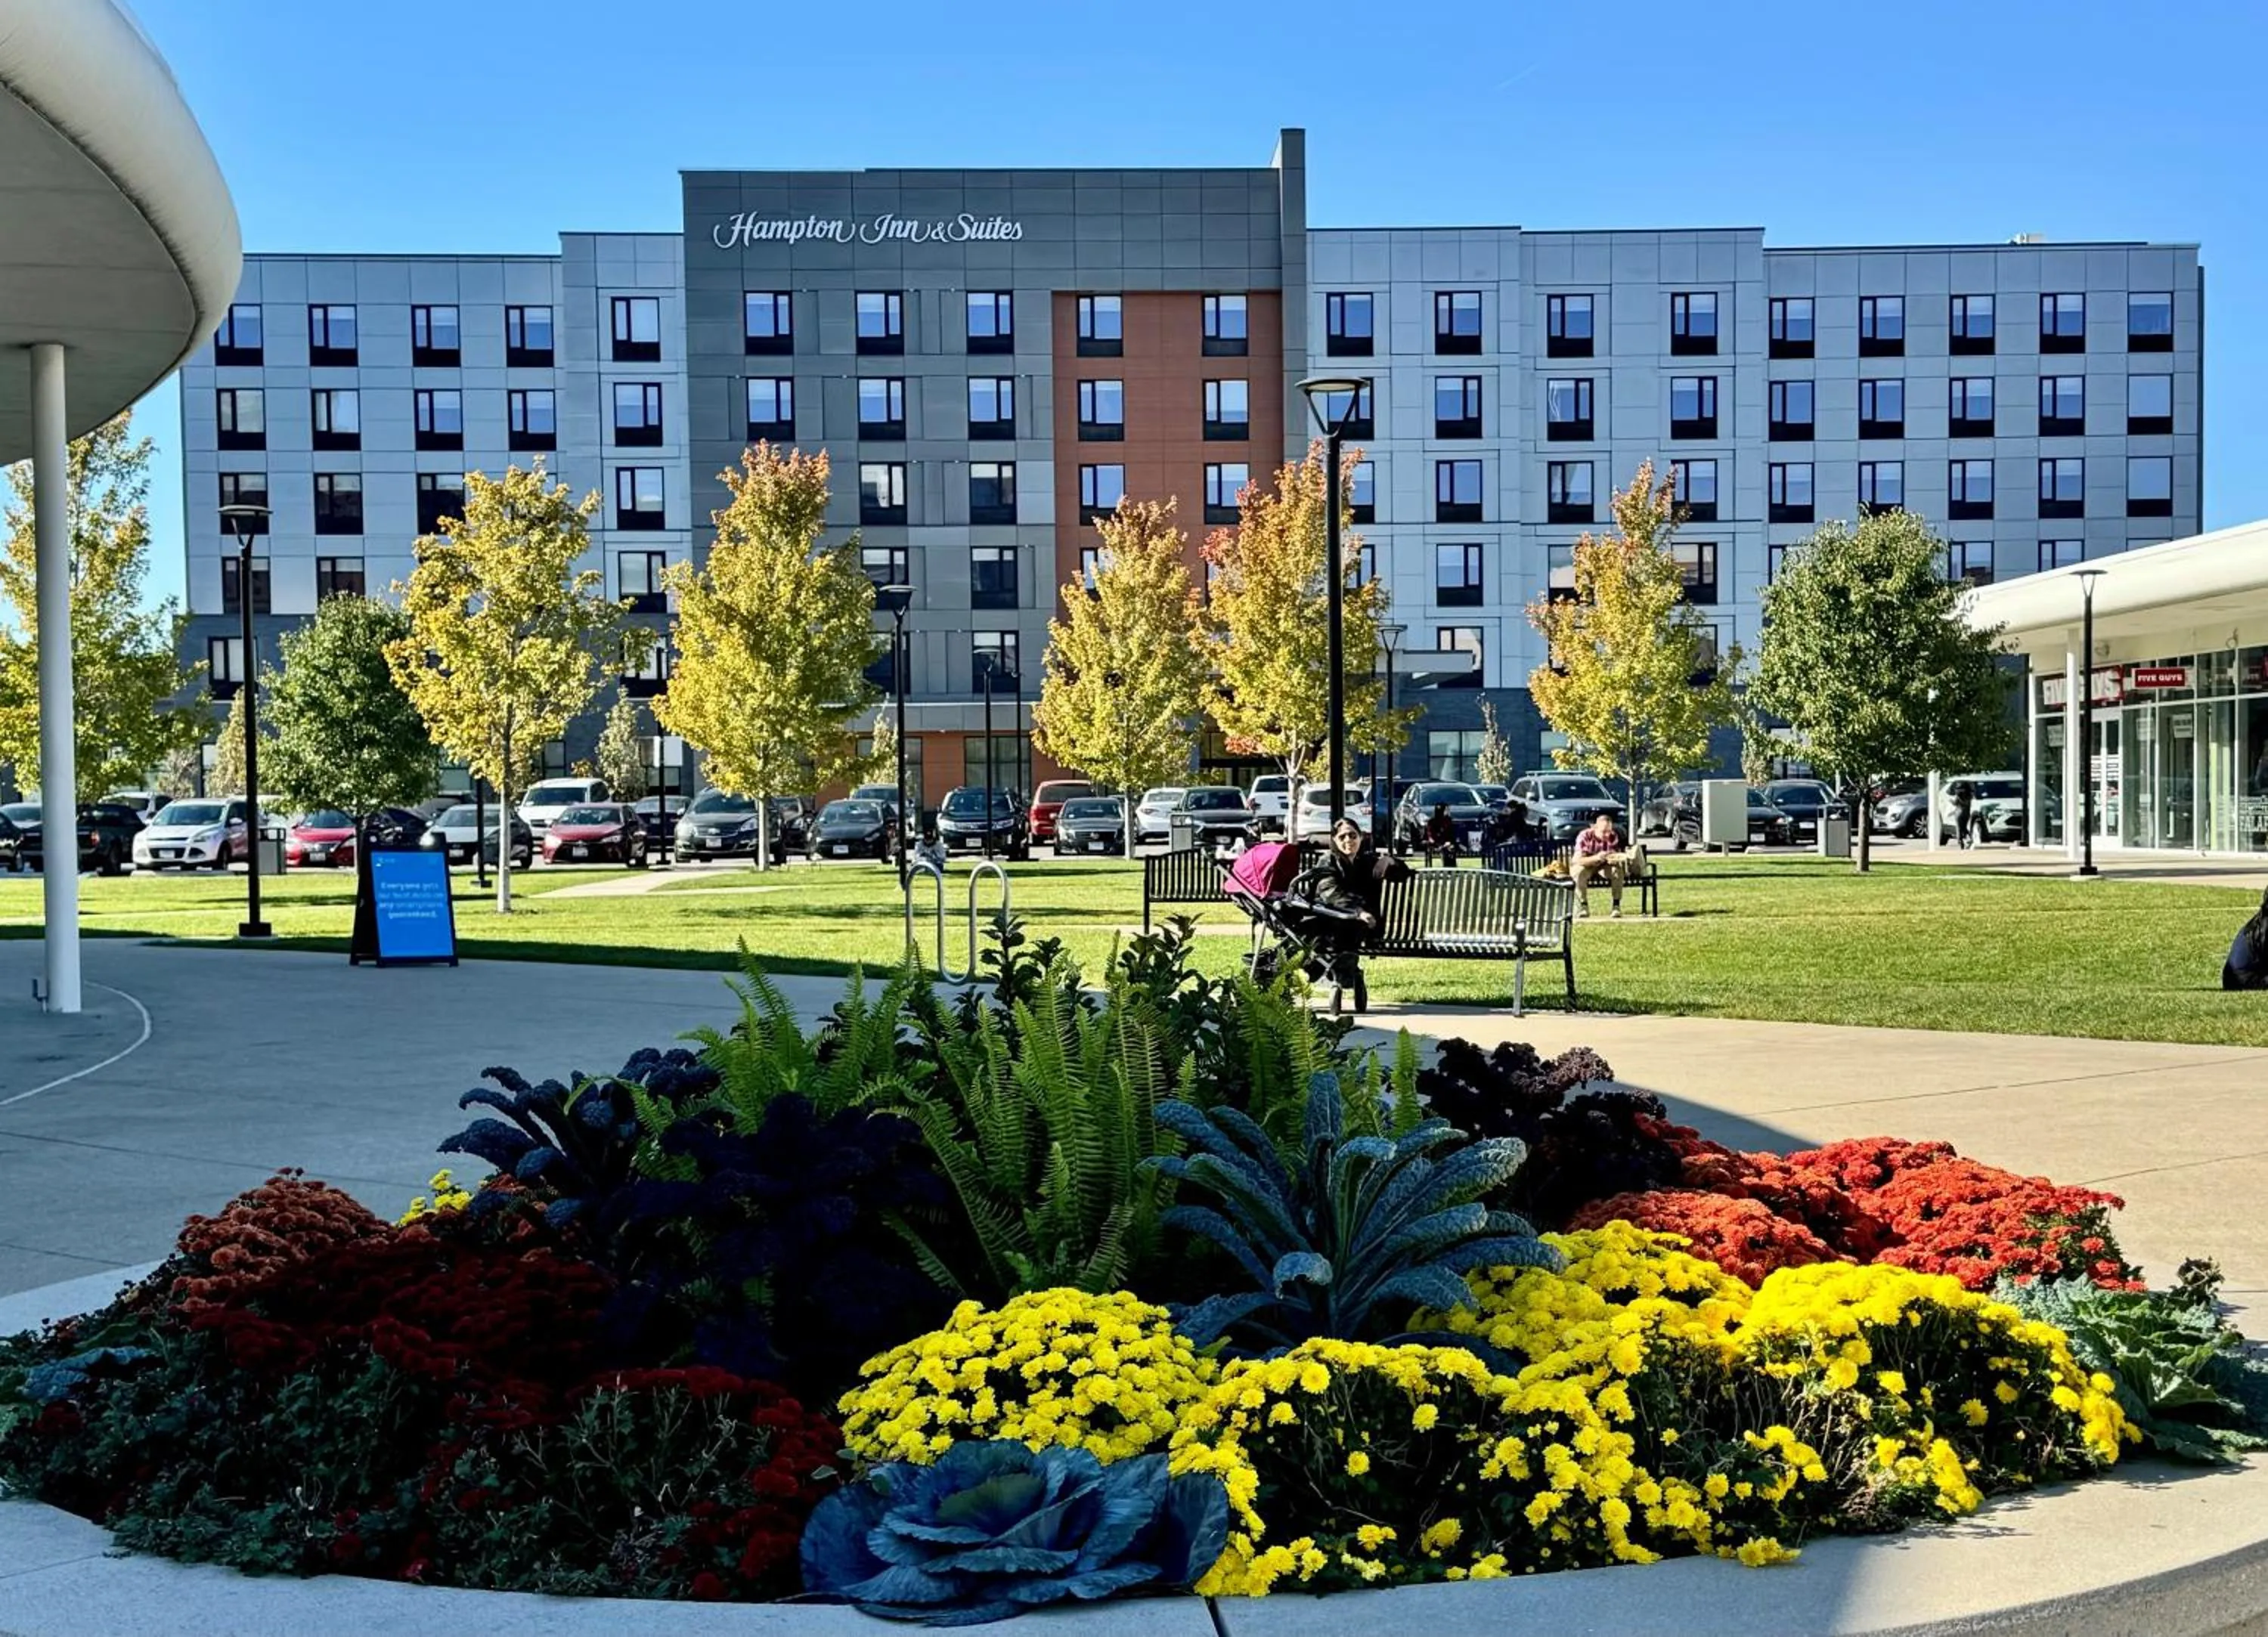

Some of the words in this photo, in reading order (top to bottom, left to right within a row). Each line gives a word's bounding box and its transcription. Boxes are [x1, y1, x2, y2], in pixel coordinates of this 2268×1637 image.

[713, 211, 855, 249] Hampton
[860, 213, 931, 243] Inn
[930, 221, 950, 242] &
[947, 213, 1023, 241] Suites
[2043, 677, 2070, 704] FIV
[2137, 674, 2157, 682] FIVE
[2158, 673, 2183, 682] GUYS
